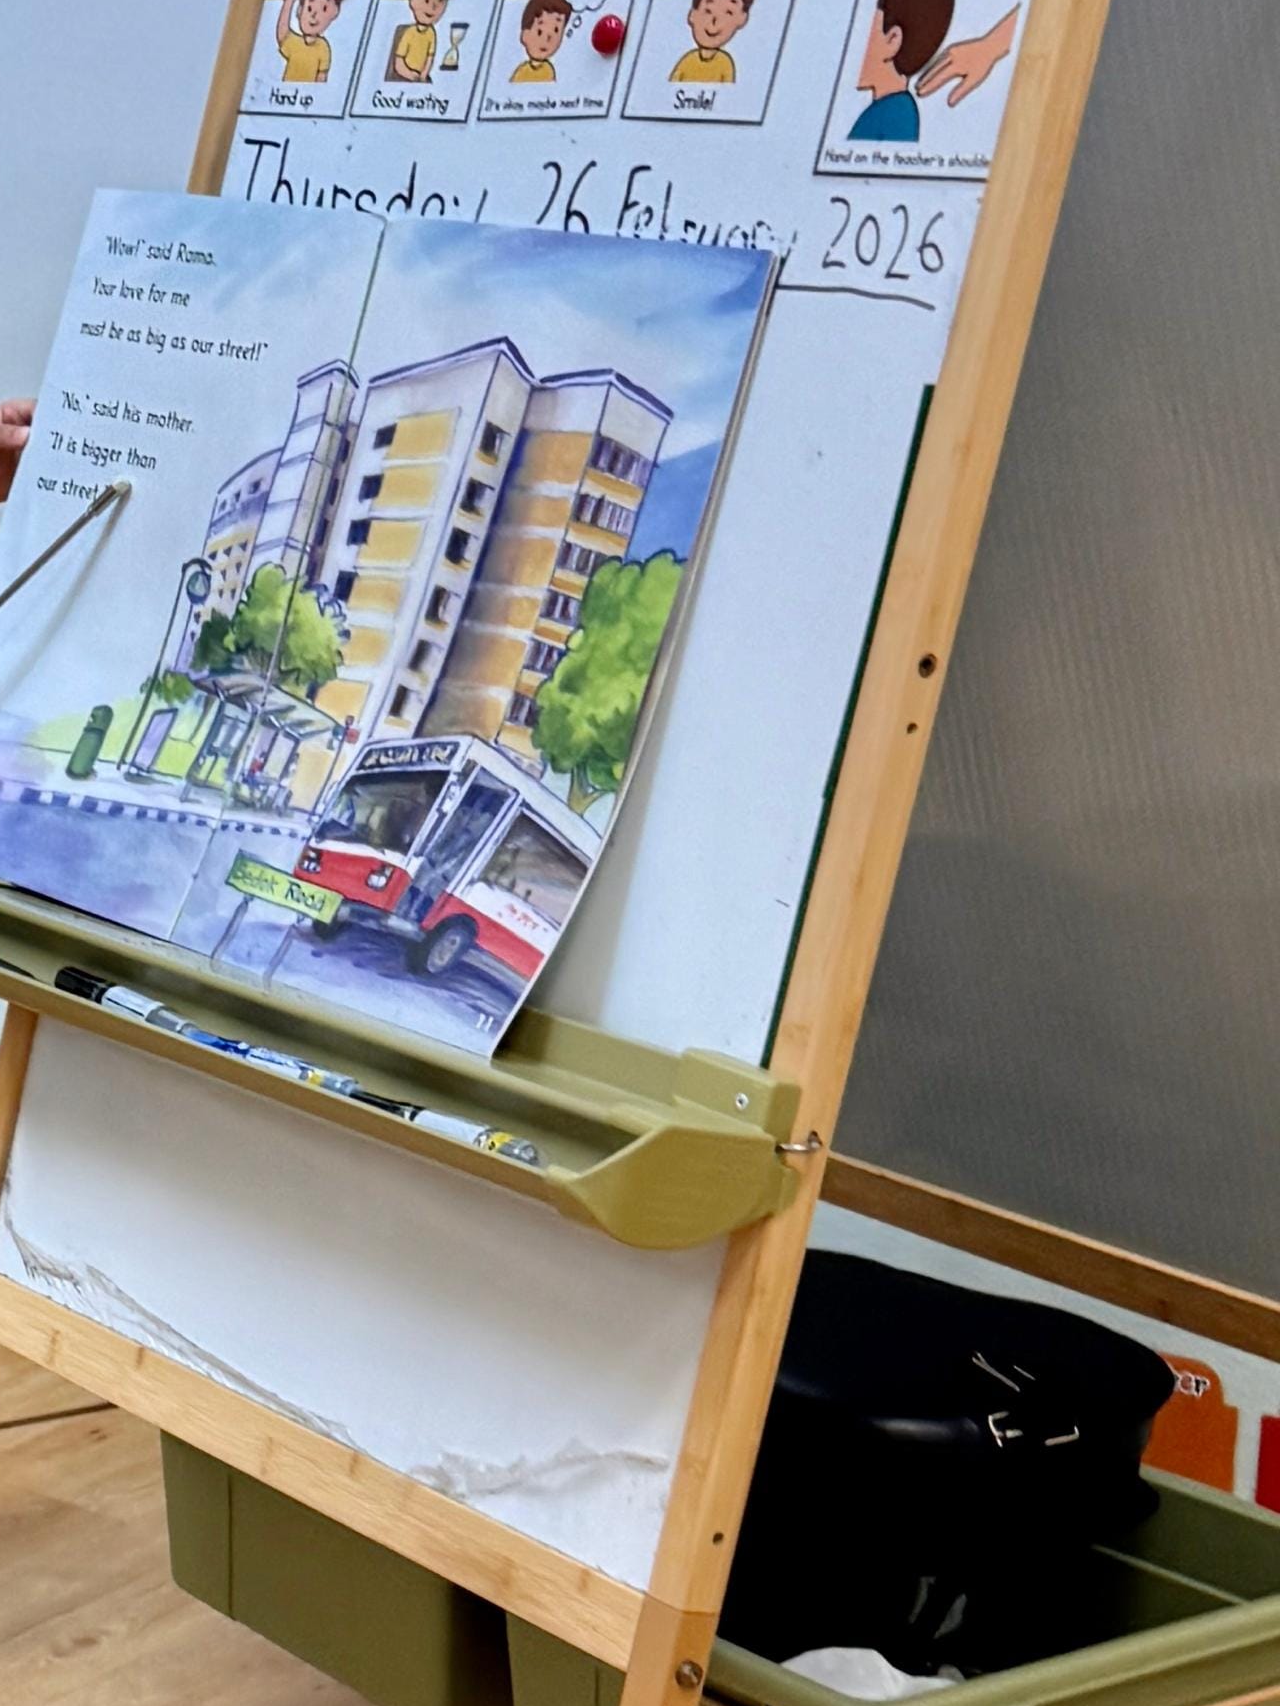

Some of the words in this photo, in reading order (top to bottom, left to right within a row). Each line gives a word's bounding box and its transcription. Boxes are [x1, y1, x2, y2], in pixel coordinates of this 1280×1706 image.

[372, 90, 402, 110] Good
[406, 92, 449, 114] waiting
[146, 241, 172, 261] said
[821, 195, 945, 281] 2026
[119, 280, 144, 302] love
[148, 283, 167, 304] for
[170, 290, 190, 307] me
[80, 321, 106, 337] must
[108, 321, 124, 341] be
[127, 328, 141, 343] as
[145, 326, 165, 354] big
[171, 336, 186, 351] as
[191, 339, 215, 355] our
[92, 398, 120, 420] said
[122, 401, 142, 423] his
[66, 435, 77, 455] is
[81, 438, 123, 468] bigger
[126, 444, 157, 470] than
[37, 476, 58, 492] our
